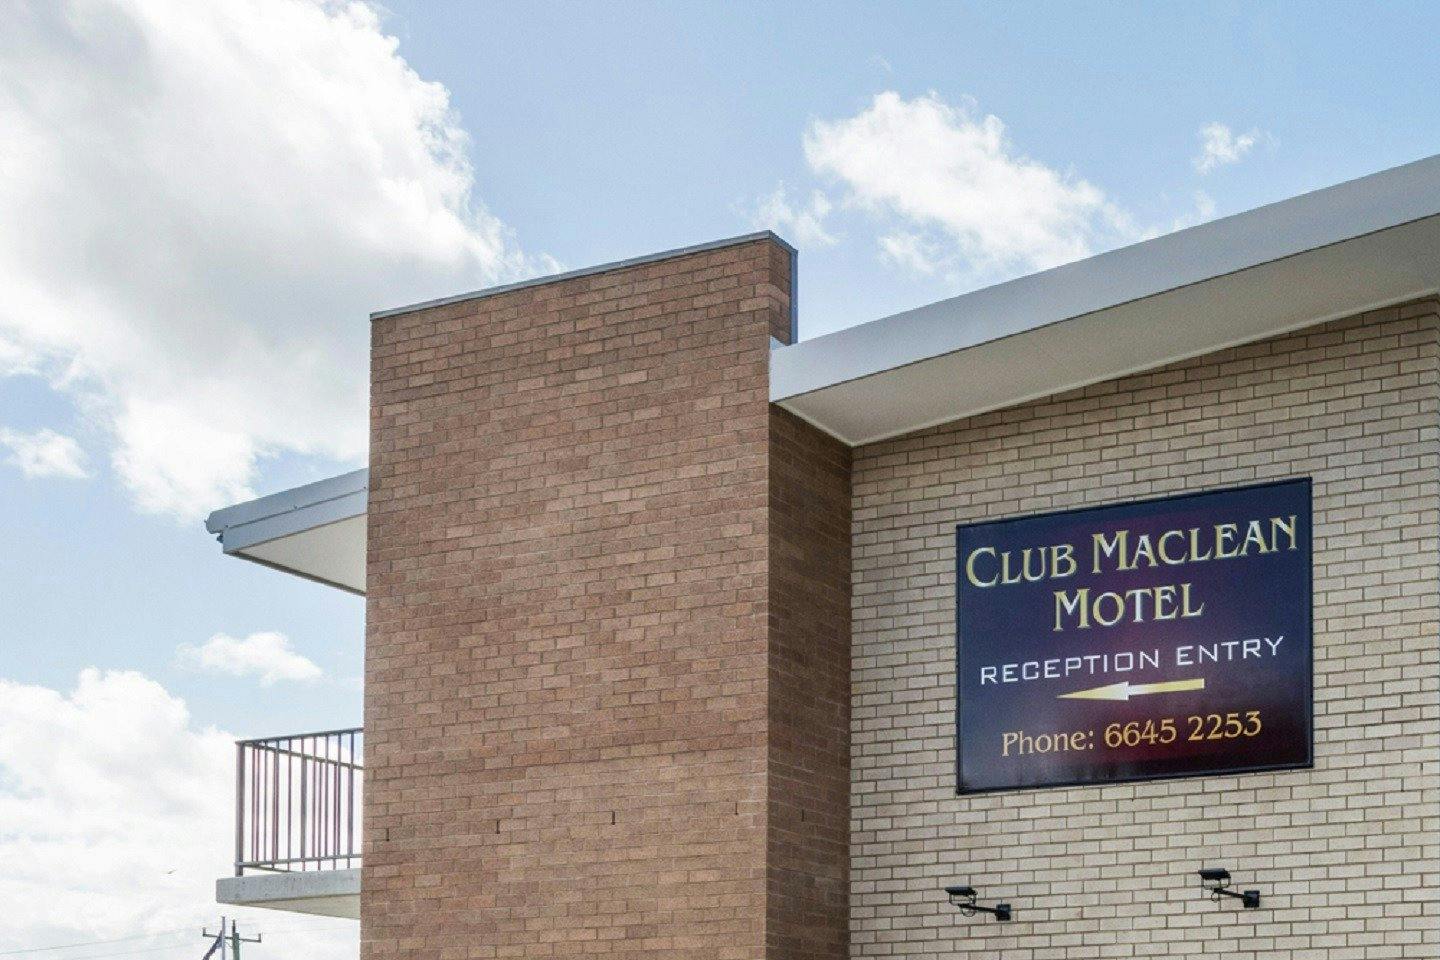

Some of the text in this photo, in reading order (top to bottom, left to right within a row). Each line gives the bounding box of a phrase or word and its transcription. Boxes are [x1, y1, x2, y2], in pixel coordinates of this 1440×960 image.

[965, 515, 1298, 588] CLUB MACLEAN
[1053, 583, 1205, 632] MOTEL
[981, 635, 1284, 685] RECEPTION ENTRY
[1001, 710, 1262, 757] Phone: 6645 2253
